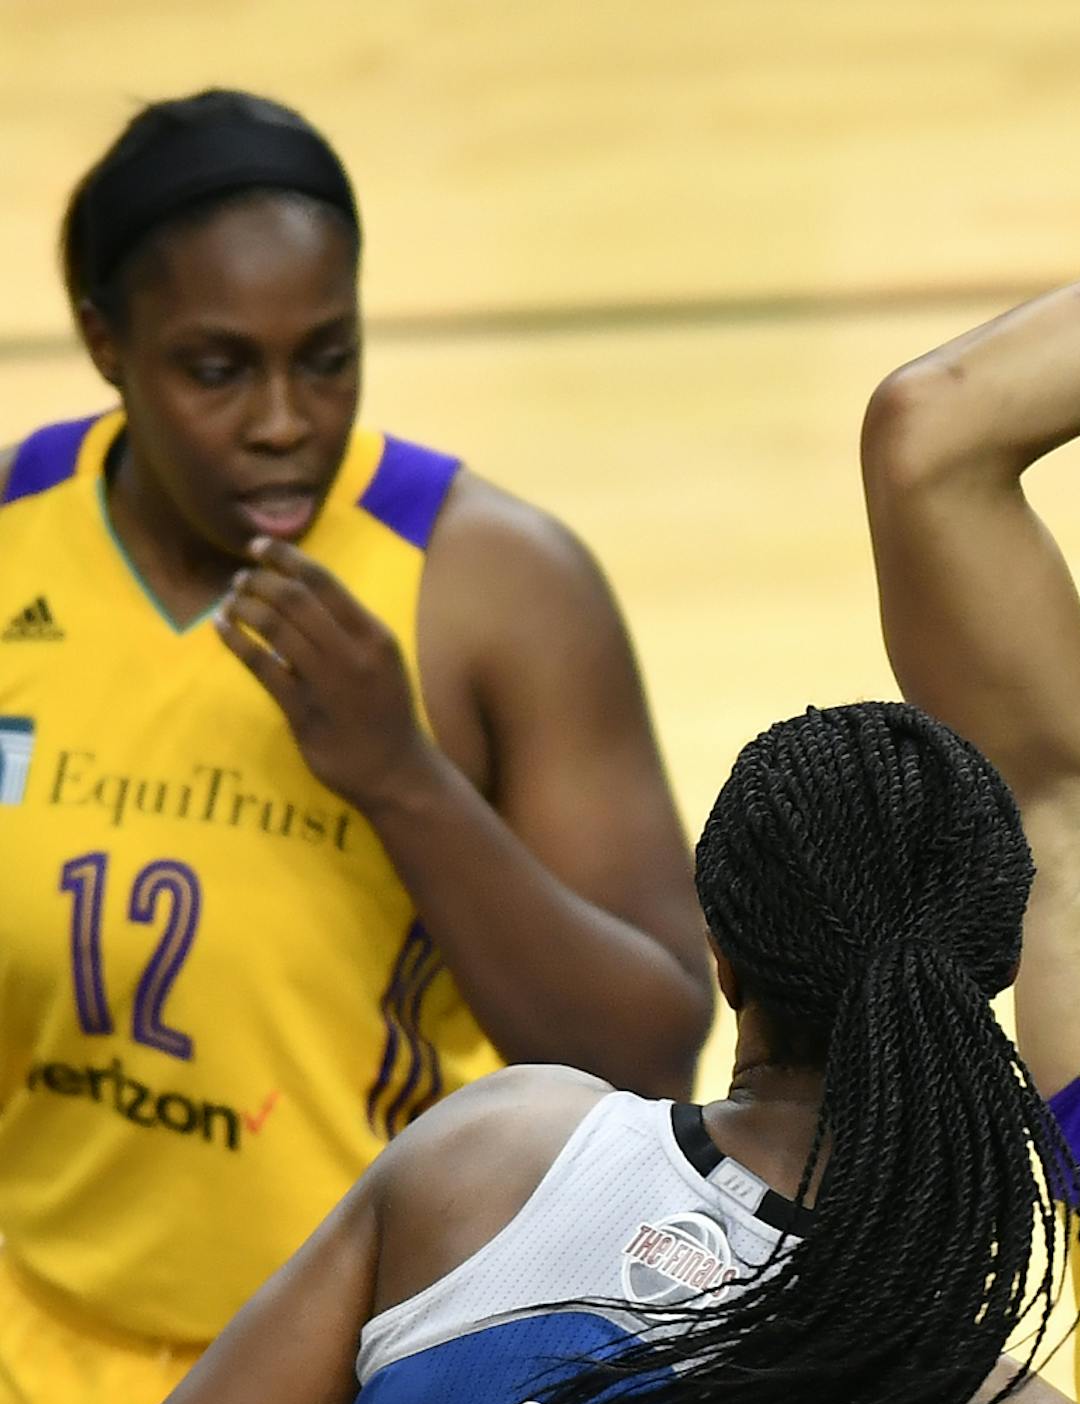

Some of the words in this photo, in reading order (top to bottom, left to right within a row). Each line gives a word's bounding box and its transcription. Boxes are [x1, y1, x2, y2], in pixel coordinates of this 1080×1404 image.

[50, 749, 352, 852] EquiTrust
[58, 851, 202, 1061] 12
[27, 1058, 241, 1151] erizon
